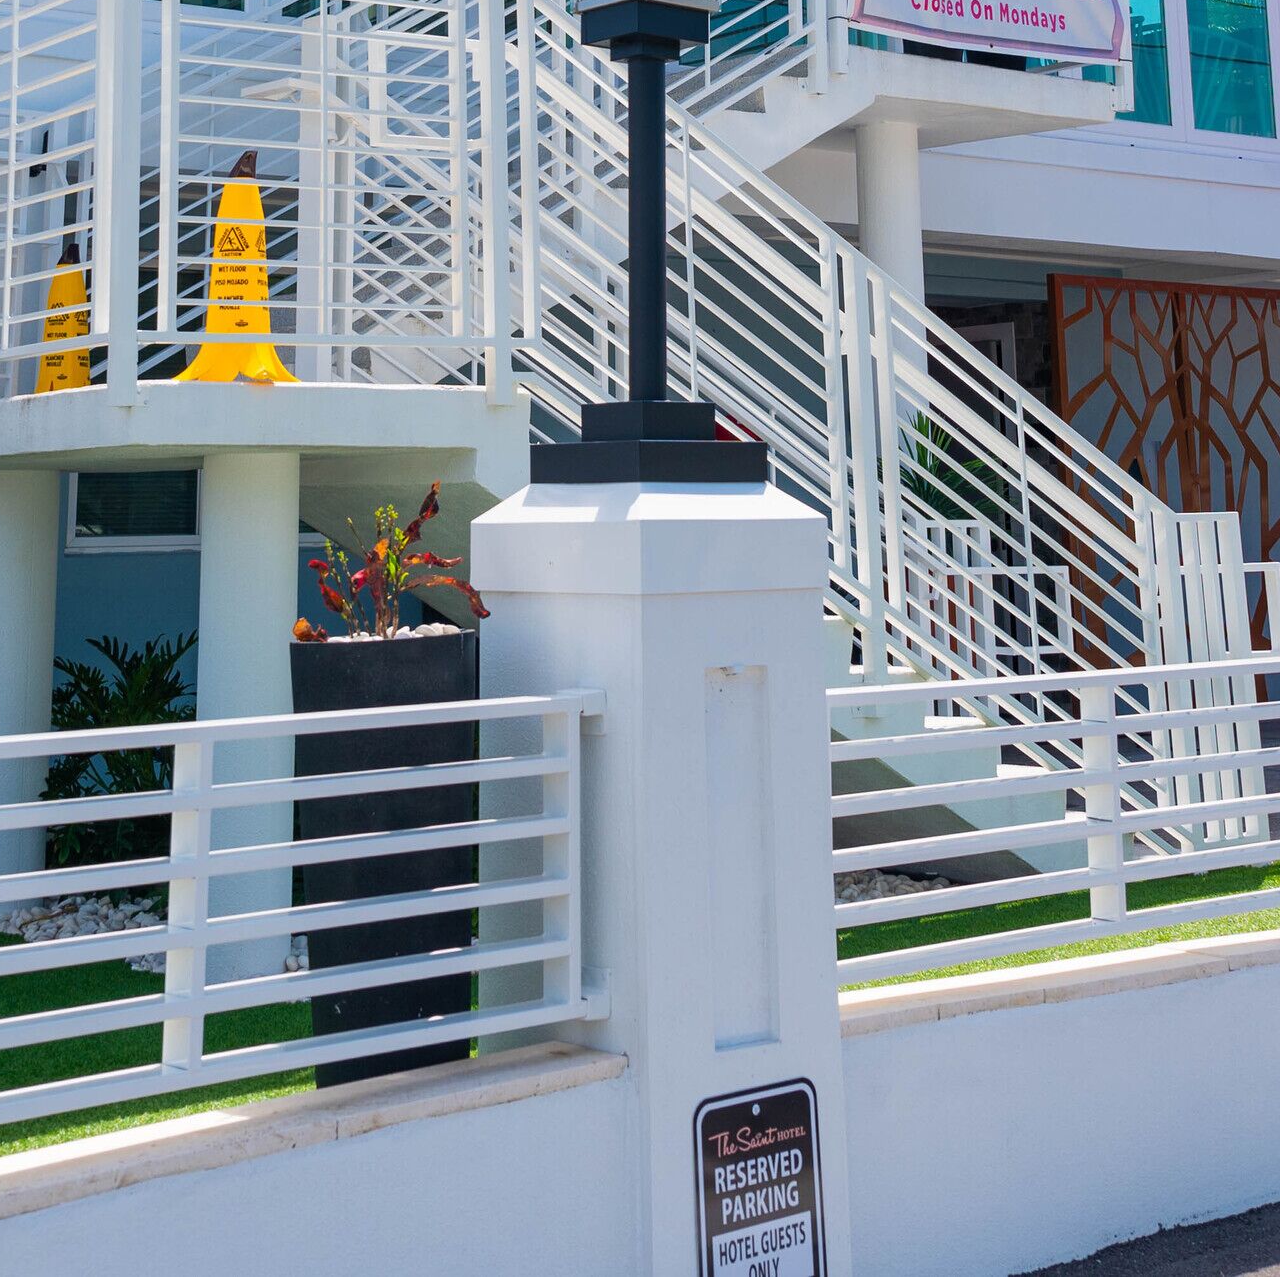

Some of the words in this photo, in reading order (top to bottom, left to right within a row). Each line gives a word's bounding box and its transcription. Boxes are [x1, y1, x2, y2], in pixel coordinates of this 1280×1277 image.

[970, 0, 994, 21] On
[999, 2, 1066, 33] Mondays
[229, 265, 247, 273] FLOOR
[708, 1131, 738, 1158] The
[736, 1126, 778, 1151] Saint
[777, 1126, 806, 1142] HOTEL
[714, 1148, 803, 1194] RESERVED
[722, 1180, 800, 1225] PARKING
[719, 1235, 758, 1267] HOTEL
[761, 1221, 806, 1254] GUESTS
[749, 1257, 780, 1277] ONLY
